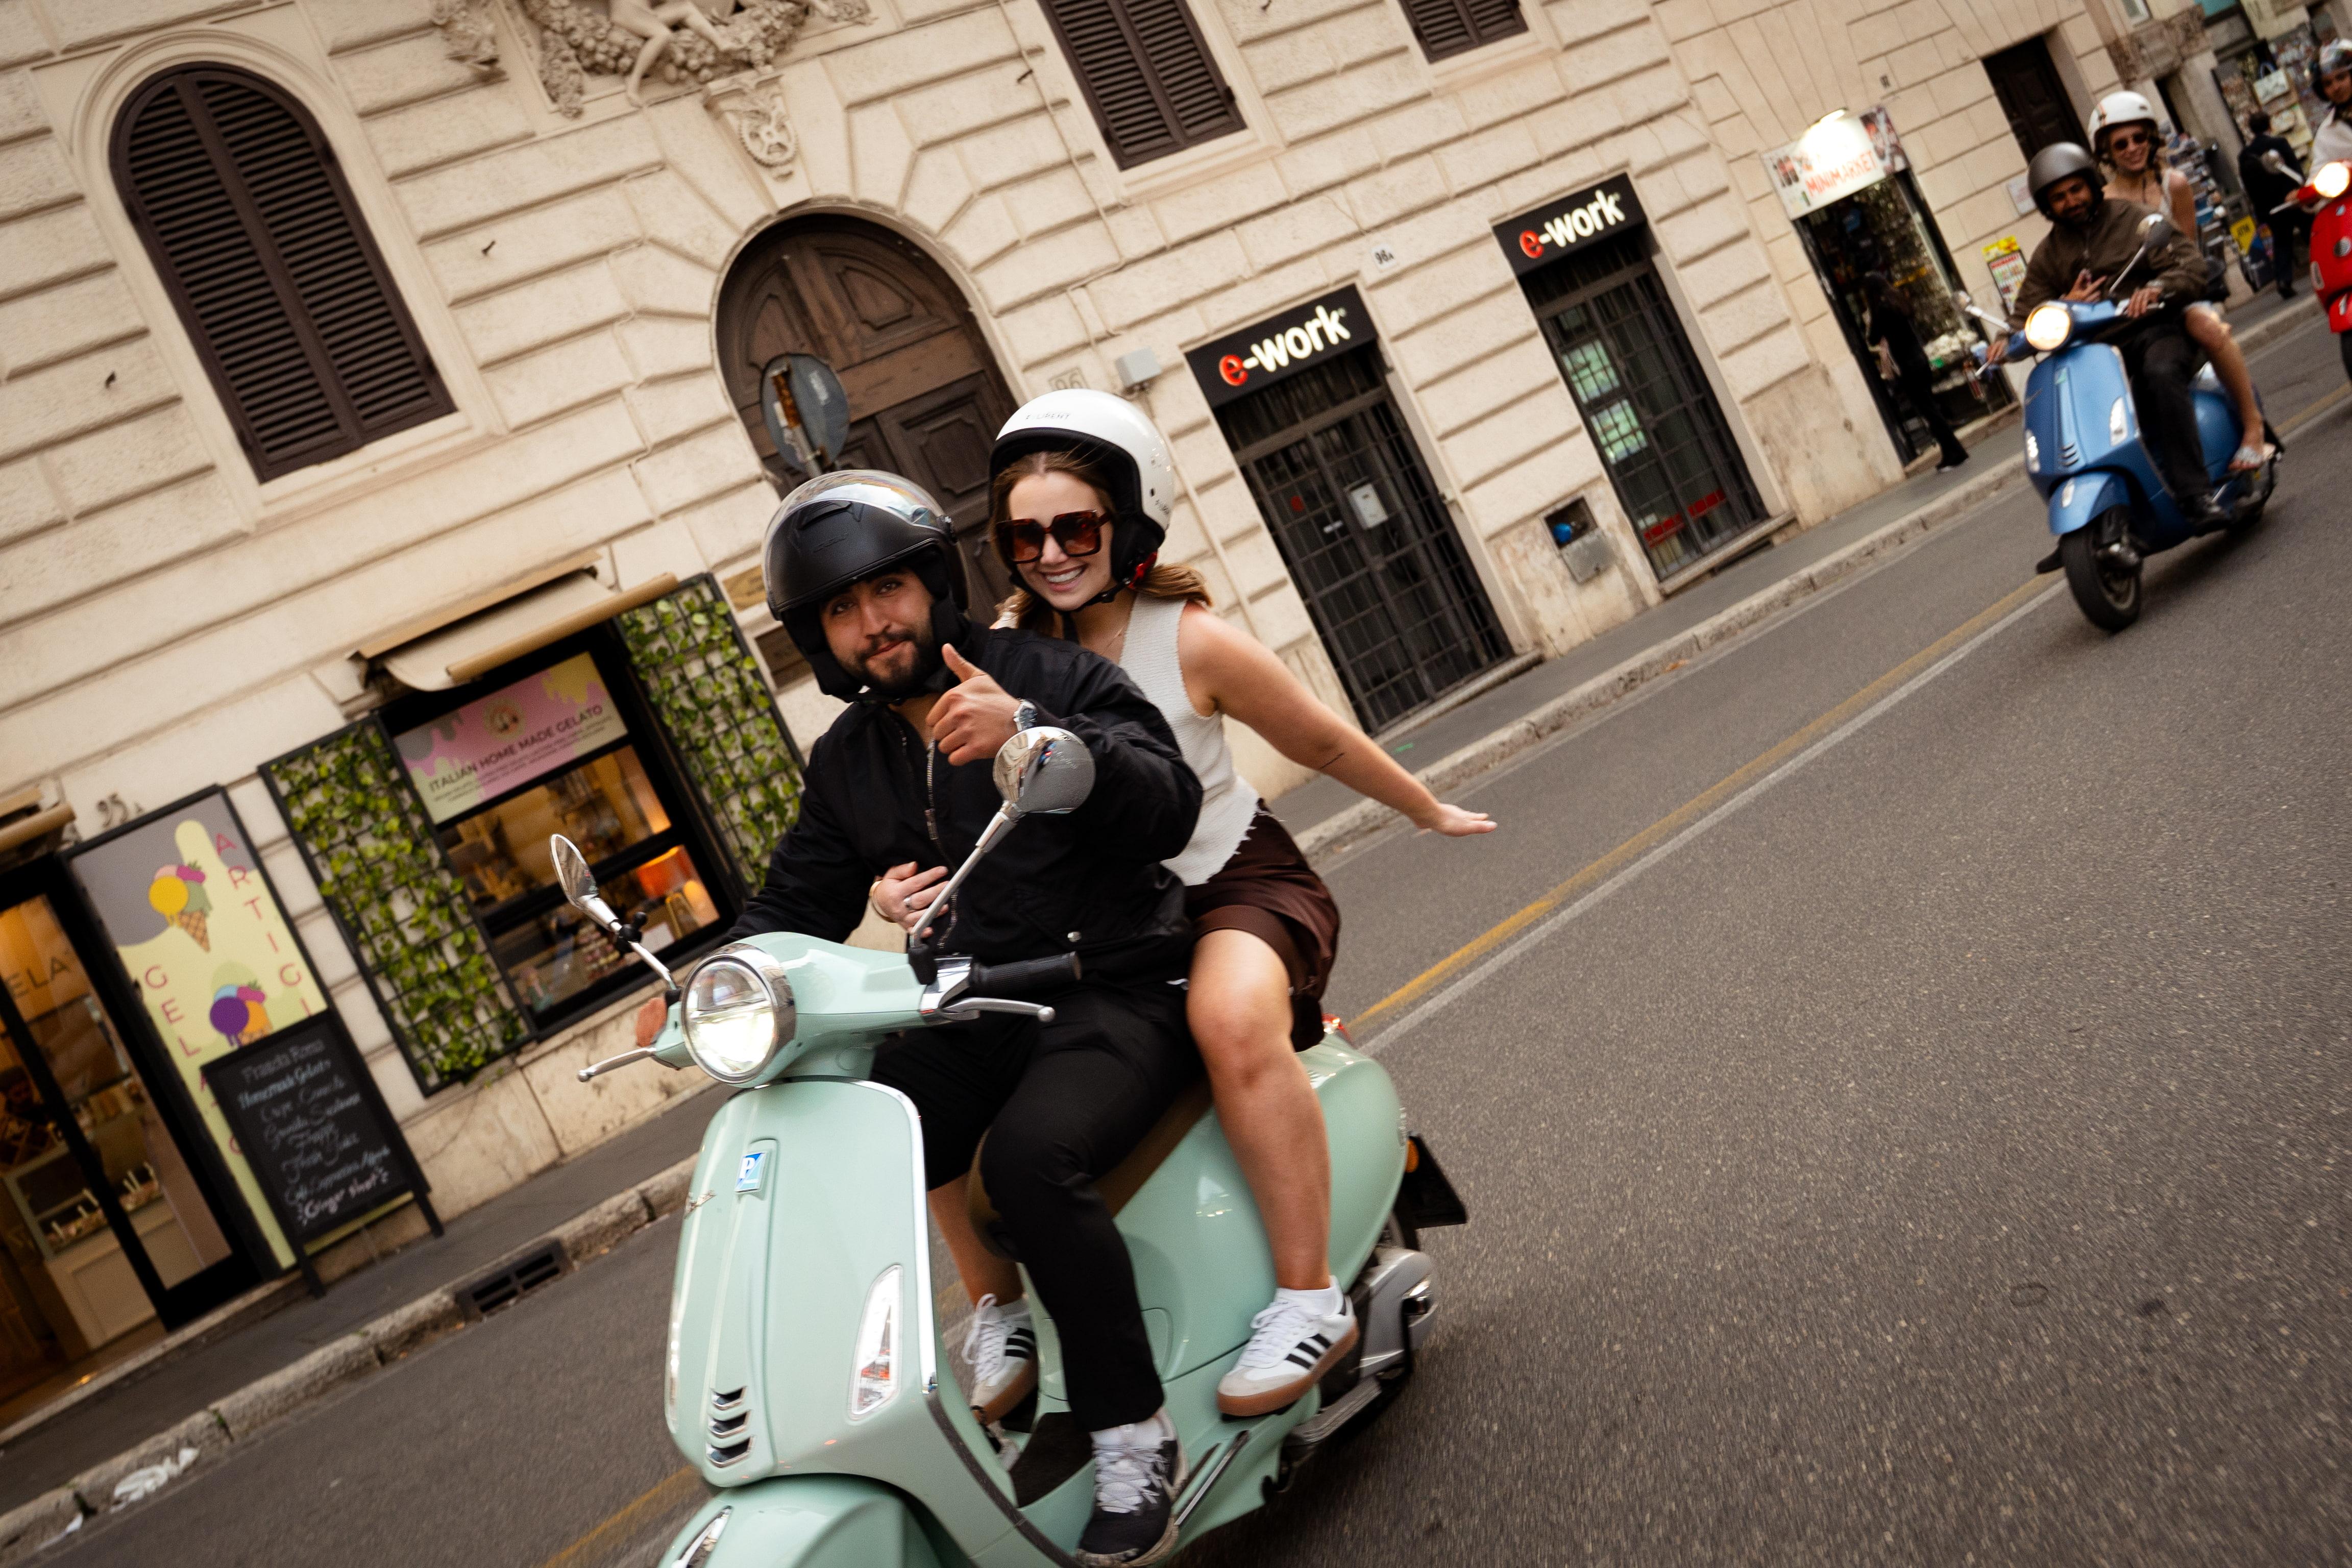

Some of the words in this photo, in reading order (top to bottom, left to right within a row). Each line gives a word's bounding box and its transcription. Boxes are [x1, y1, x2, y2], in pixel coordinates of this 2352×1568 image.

[1805, 150, 1877, 197] MINIMARKET
[1520, 189, 1625, 259] e-work
[1219, 305, 1351, 386] e-work
[429, 763, 478, 792] ITALIAN
[479, 744, 515, 768] HOME
[519, 726, 553, 749] MADE
[556, 705, 603, 733] GELATO
